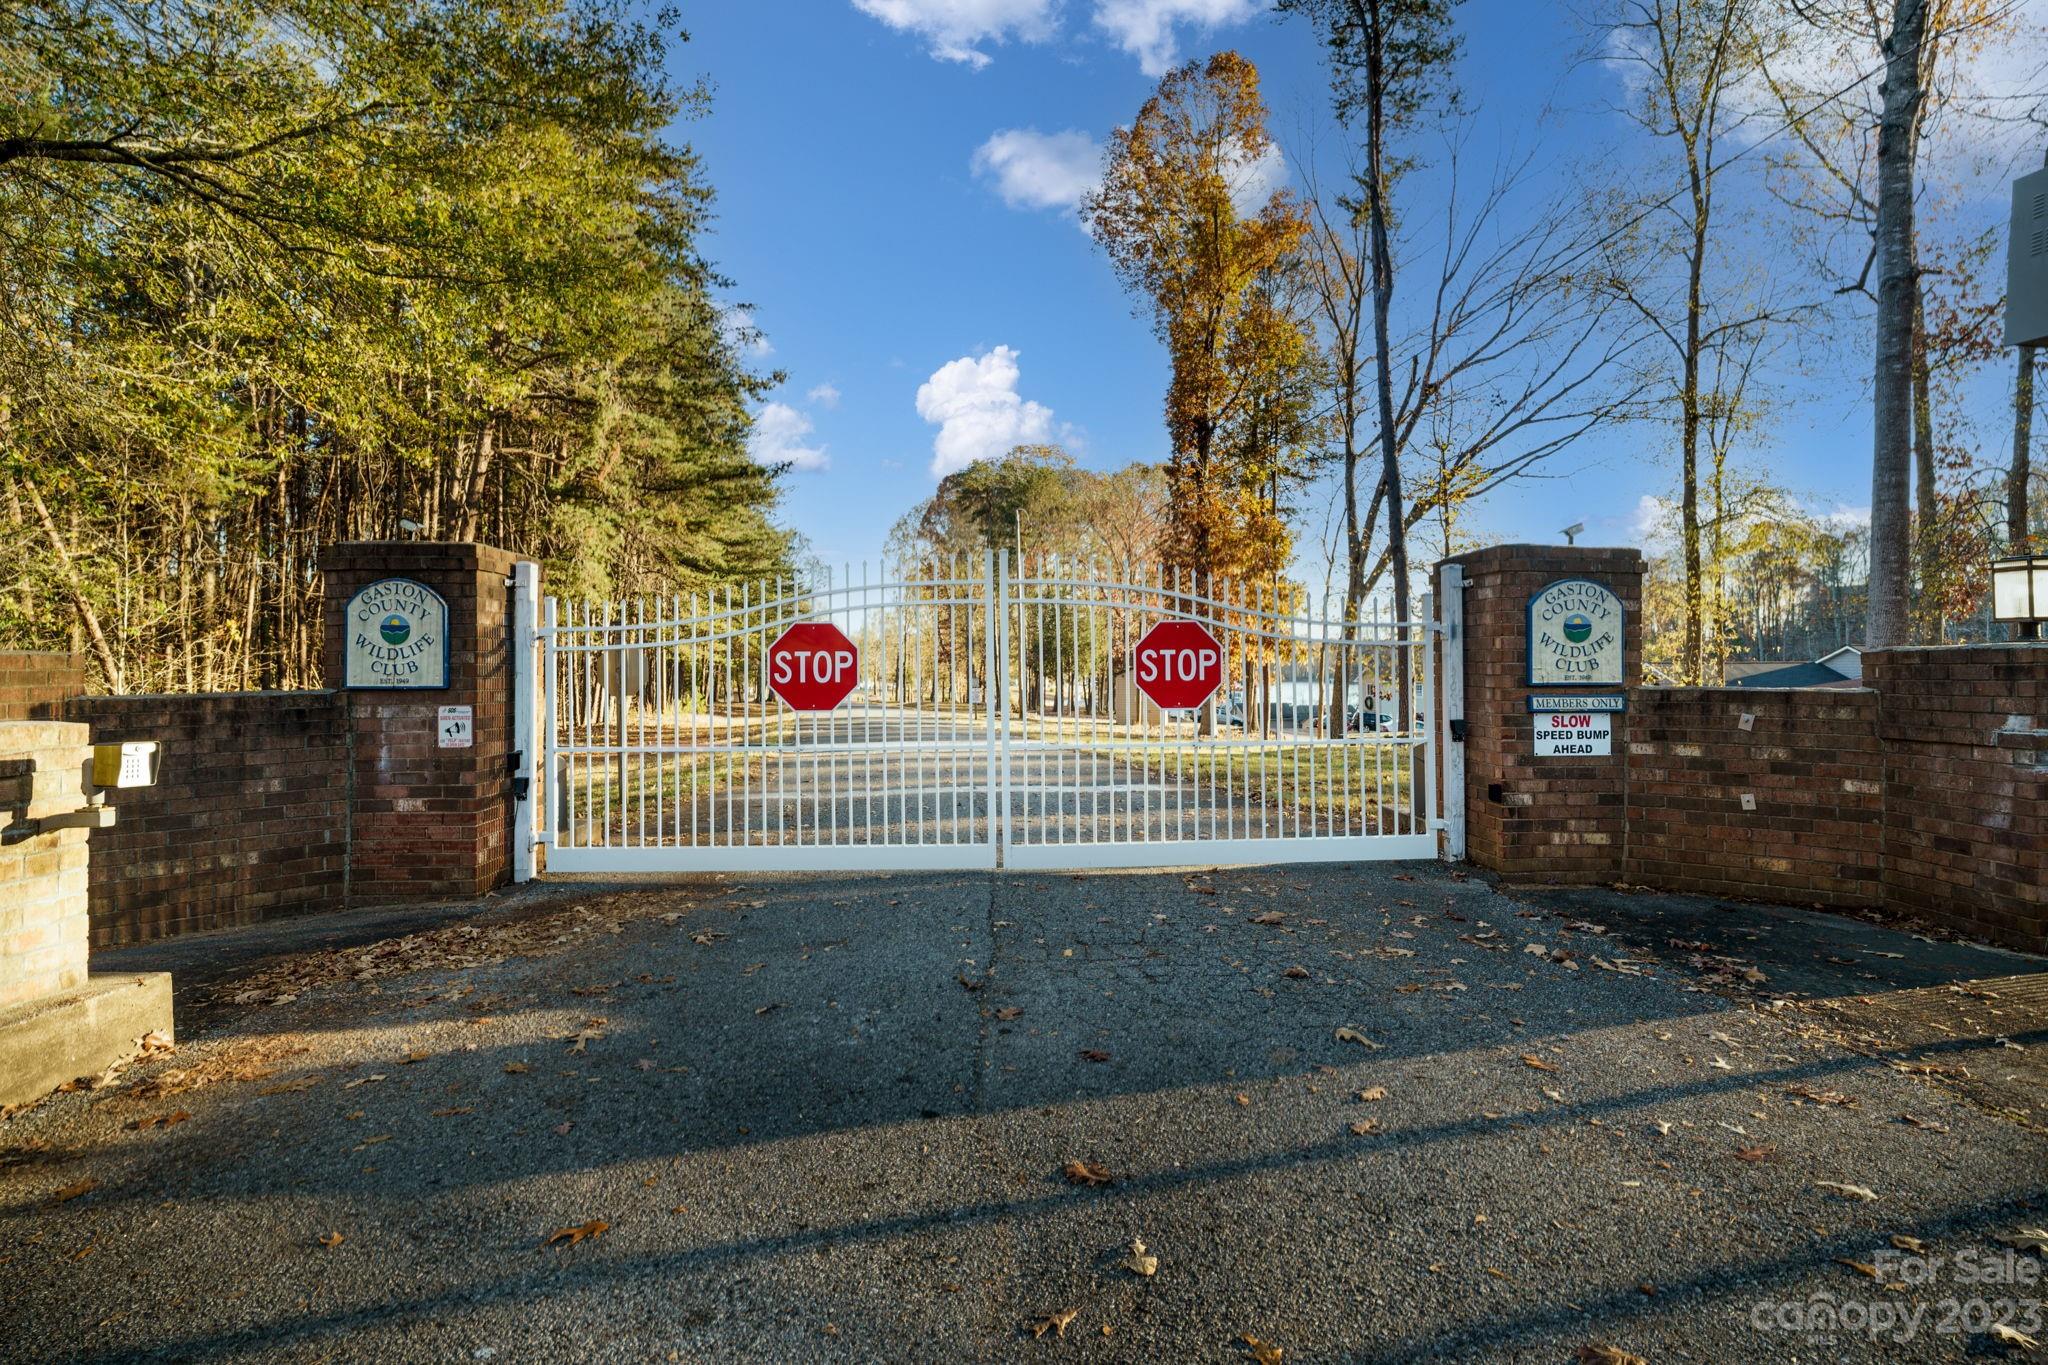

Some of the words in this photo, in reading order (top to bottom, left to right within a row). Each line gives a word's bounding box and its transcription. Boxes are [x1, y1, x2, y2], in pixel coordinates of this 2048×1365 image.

[361, 583, 429, 605] GASTON
[1544, 583, 1610, 605] GASTON
[358, 598, 431, 622] COUNTY
[1542, 598, 1611, 622] COUNTY
[355, 632, 435, 661] WILDLIFE
[1539, 631, 1614, 658] WILDLIFE
[371, 660, 419, 676] CLUB
[773, 650, 853, 684] STOP
[1140, 648, 1217, 682] STOP
[1555, 658, 1600, 673] CLUB
[1535, 698, 1588, 708] MEMBERS
[1591, 698, 1620, 708] ONLY
[1551, 715, 1591, 728] SLOW
[1536, 730, 1573, 740] SPEED
[1577, 730, 1610, 740] BUMP
[1553, 744, 1593, 754] AHEAD
